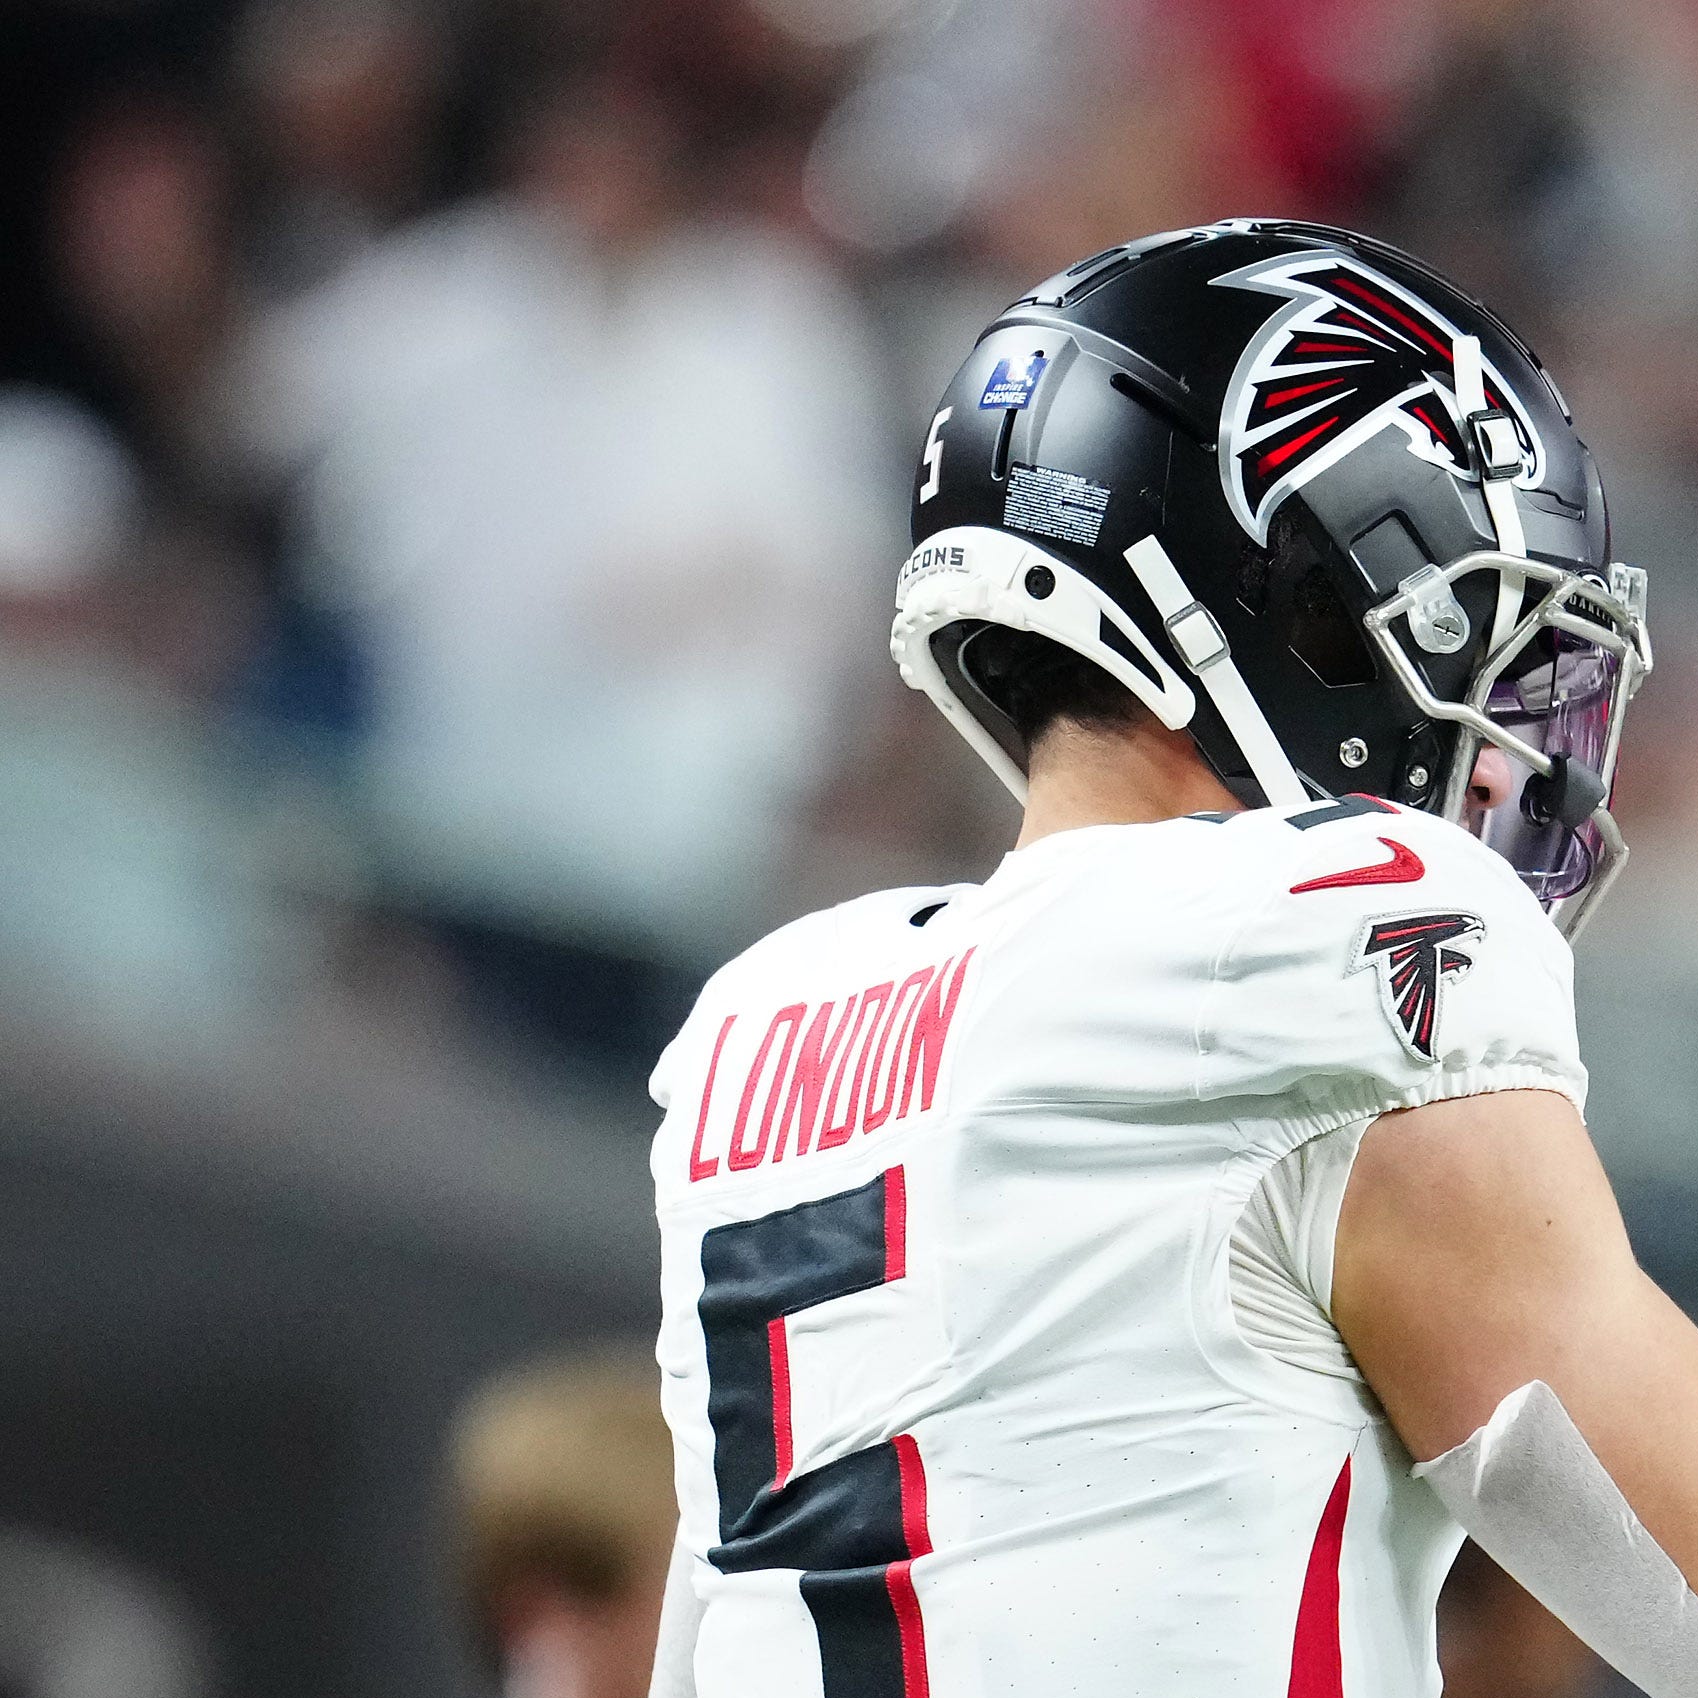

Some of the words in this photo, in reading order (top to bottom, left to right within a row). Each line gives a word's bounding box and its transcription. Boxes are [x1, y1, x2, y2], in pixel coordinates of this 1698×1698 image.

[983, 391, 1027, 404] CHANGE
[920, 405, 953, 505] 5
[1036, 467, 1087, 484] WARNING
[899, 547, 964, 586] LCONS
[689, 945, 977, 1183] LONDON
